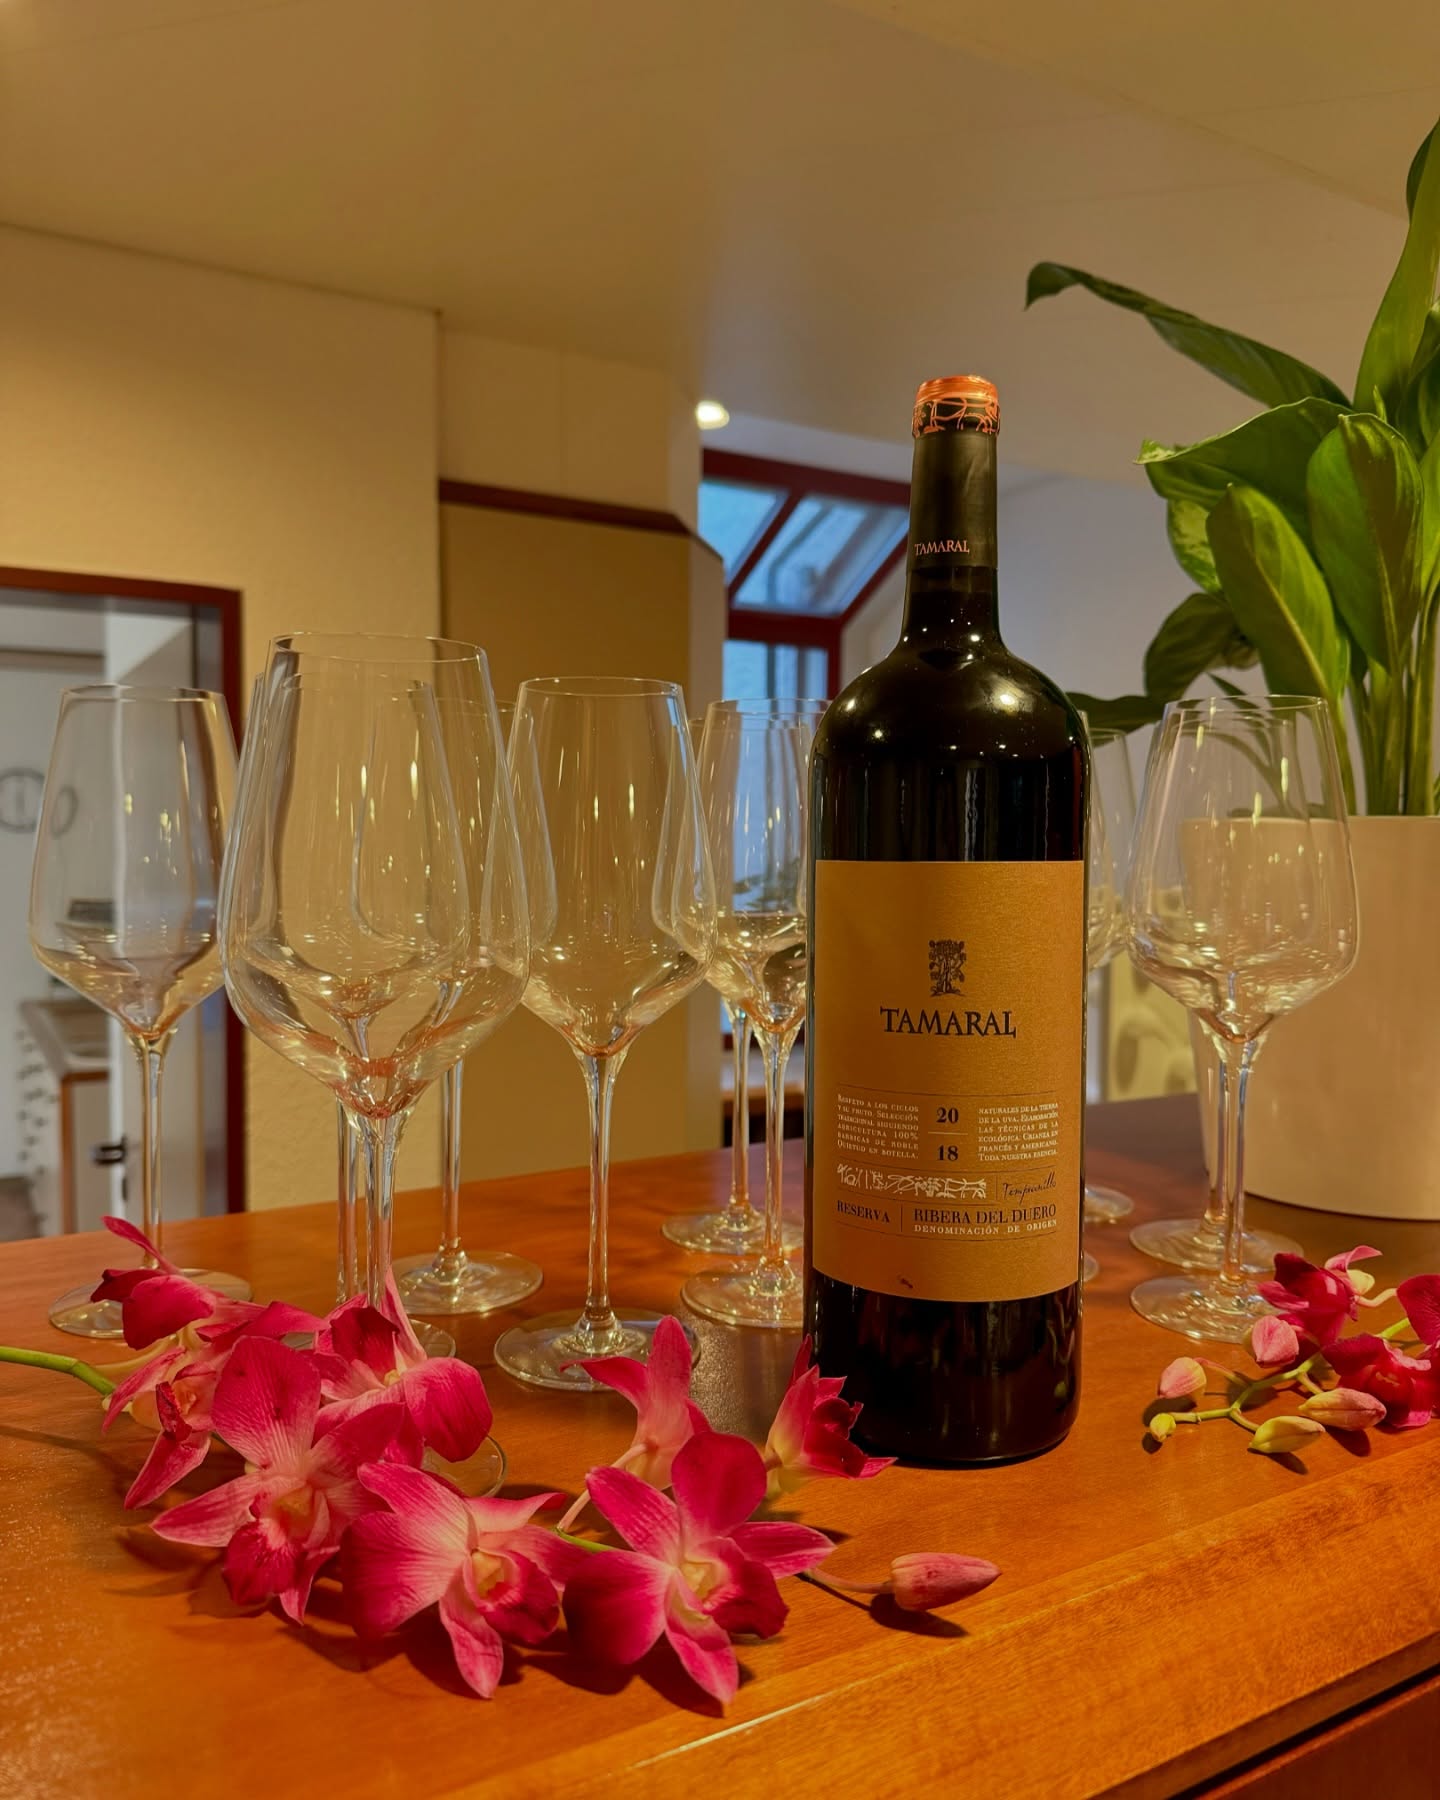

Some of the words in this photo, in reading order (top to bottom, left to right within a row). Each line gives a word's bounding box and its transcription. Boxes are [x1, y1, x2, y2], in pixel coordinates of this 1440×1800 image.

[914, 539, 970, 556] TAMARAL
[880, 1006, 1016, 1038] TAMARAL
[874, 1101, 888, 1110] LOS
[891, 1104, 919, 1113] CICLOS
[876, 1109, 919, 1121] SELECCIÓN
[978, 1106, 1019, 1115] NATURALES
[1020, 1105, 1029, 1113] DE
[1039, 1102, 1058, 1111] TIERRA
[936, 1107, 959, 1124] 20
[991, 1116, 1000, 1124] LA
[837, 1122, 887, 1138] AGRICULTURA
[894, 1130, 919, 1141] 100%
[978, 1126, 993, 1134] LAS
[998, 1123, 1035, 1133] TÉCNICAS
[1039, 1122, 1048, 1130] DE
[1022, 1132, 1050, 1141] CRIANZA
[1051, 1129, 1058, 1137] EN
[837, 1131, 870, 1144] BARRICAS
[874, 1139, 886, 1147] DE
[891, 1141, 919, 1151] ROBLE
[837, 1139, 866, 1153] QUIETUD
[868, 1147, 878, 1155] EN
[881, 1149, 919, 1159] BOTELLA.
[978, 1142, 1013, 1152] FRANCÉS
[937, 1145, 959, 1161] 18
[978, 1152, 1000, 1161] TODA
[1001, 1152, 1032, 1161] NUESTRA
[837, 1199, 891, 1224] RESERVA
[914, 1208, 971, 1224] RIBERA
[976, 1209, 1008, 1224] DEL
[1012, 1203, 1057, 1223] DUERO
[914, 1224, 999, 1236] DENOMINACIÓN
[1007, 1225, 1020, 1234] DE
[1026, 1219, 1057, 1232] ORIGEN
